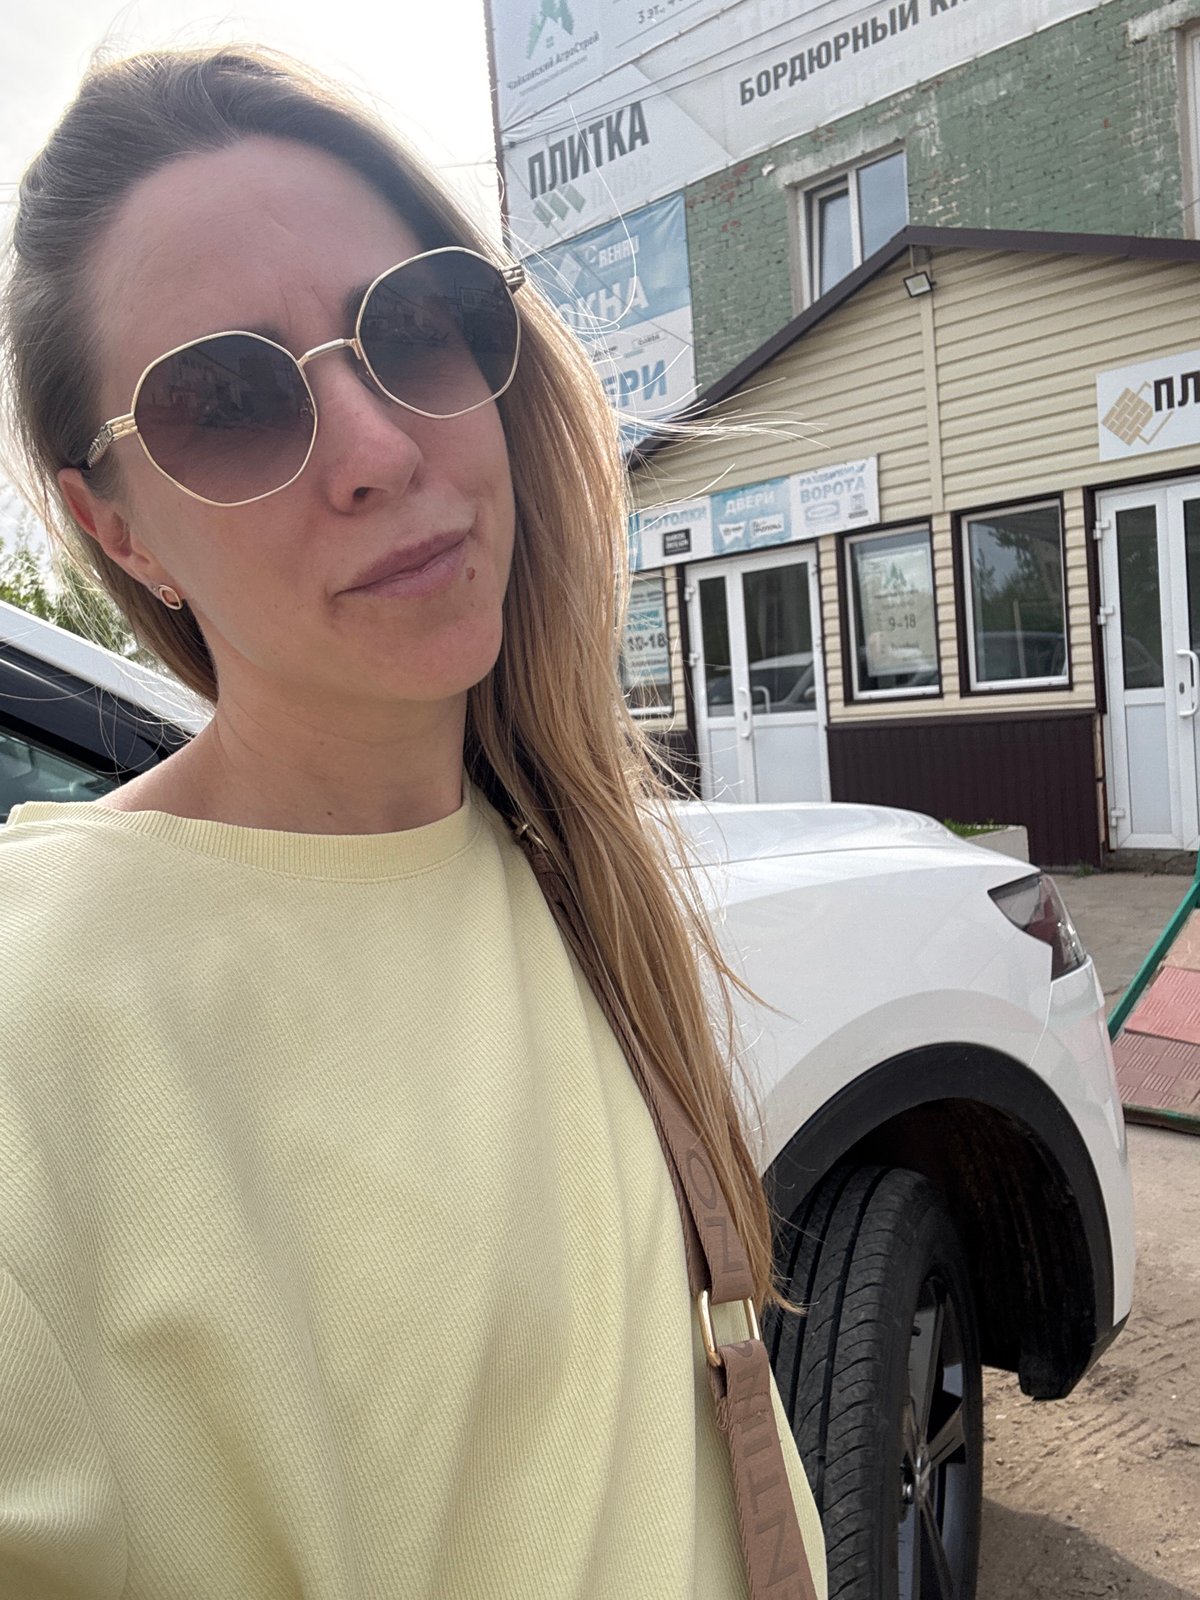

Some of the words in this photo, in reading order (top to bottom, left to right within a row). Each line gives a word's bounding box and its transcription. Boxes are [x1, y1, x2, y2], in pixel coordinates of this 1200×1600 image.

[739, 0, 921, 106] БОРДЮРНЫЙ
[527, 100, 650, 200] ПЛИТКА
[1153, 370, 1200, 412] ПЛ
[724, 491, 777, 517] ДВЕРИ
[800, 475, 866, 503] ВОРОТА
